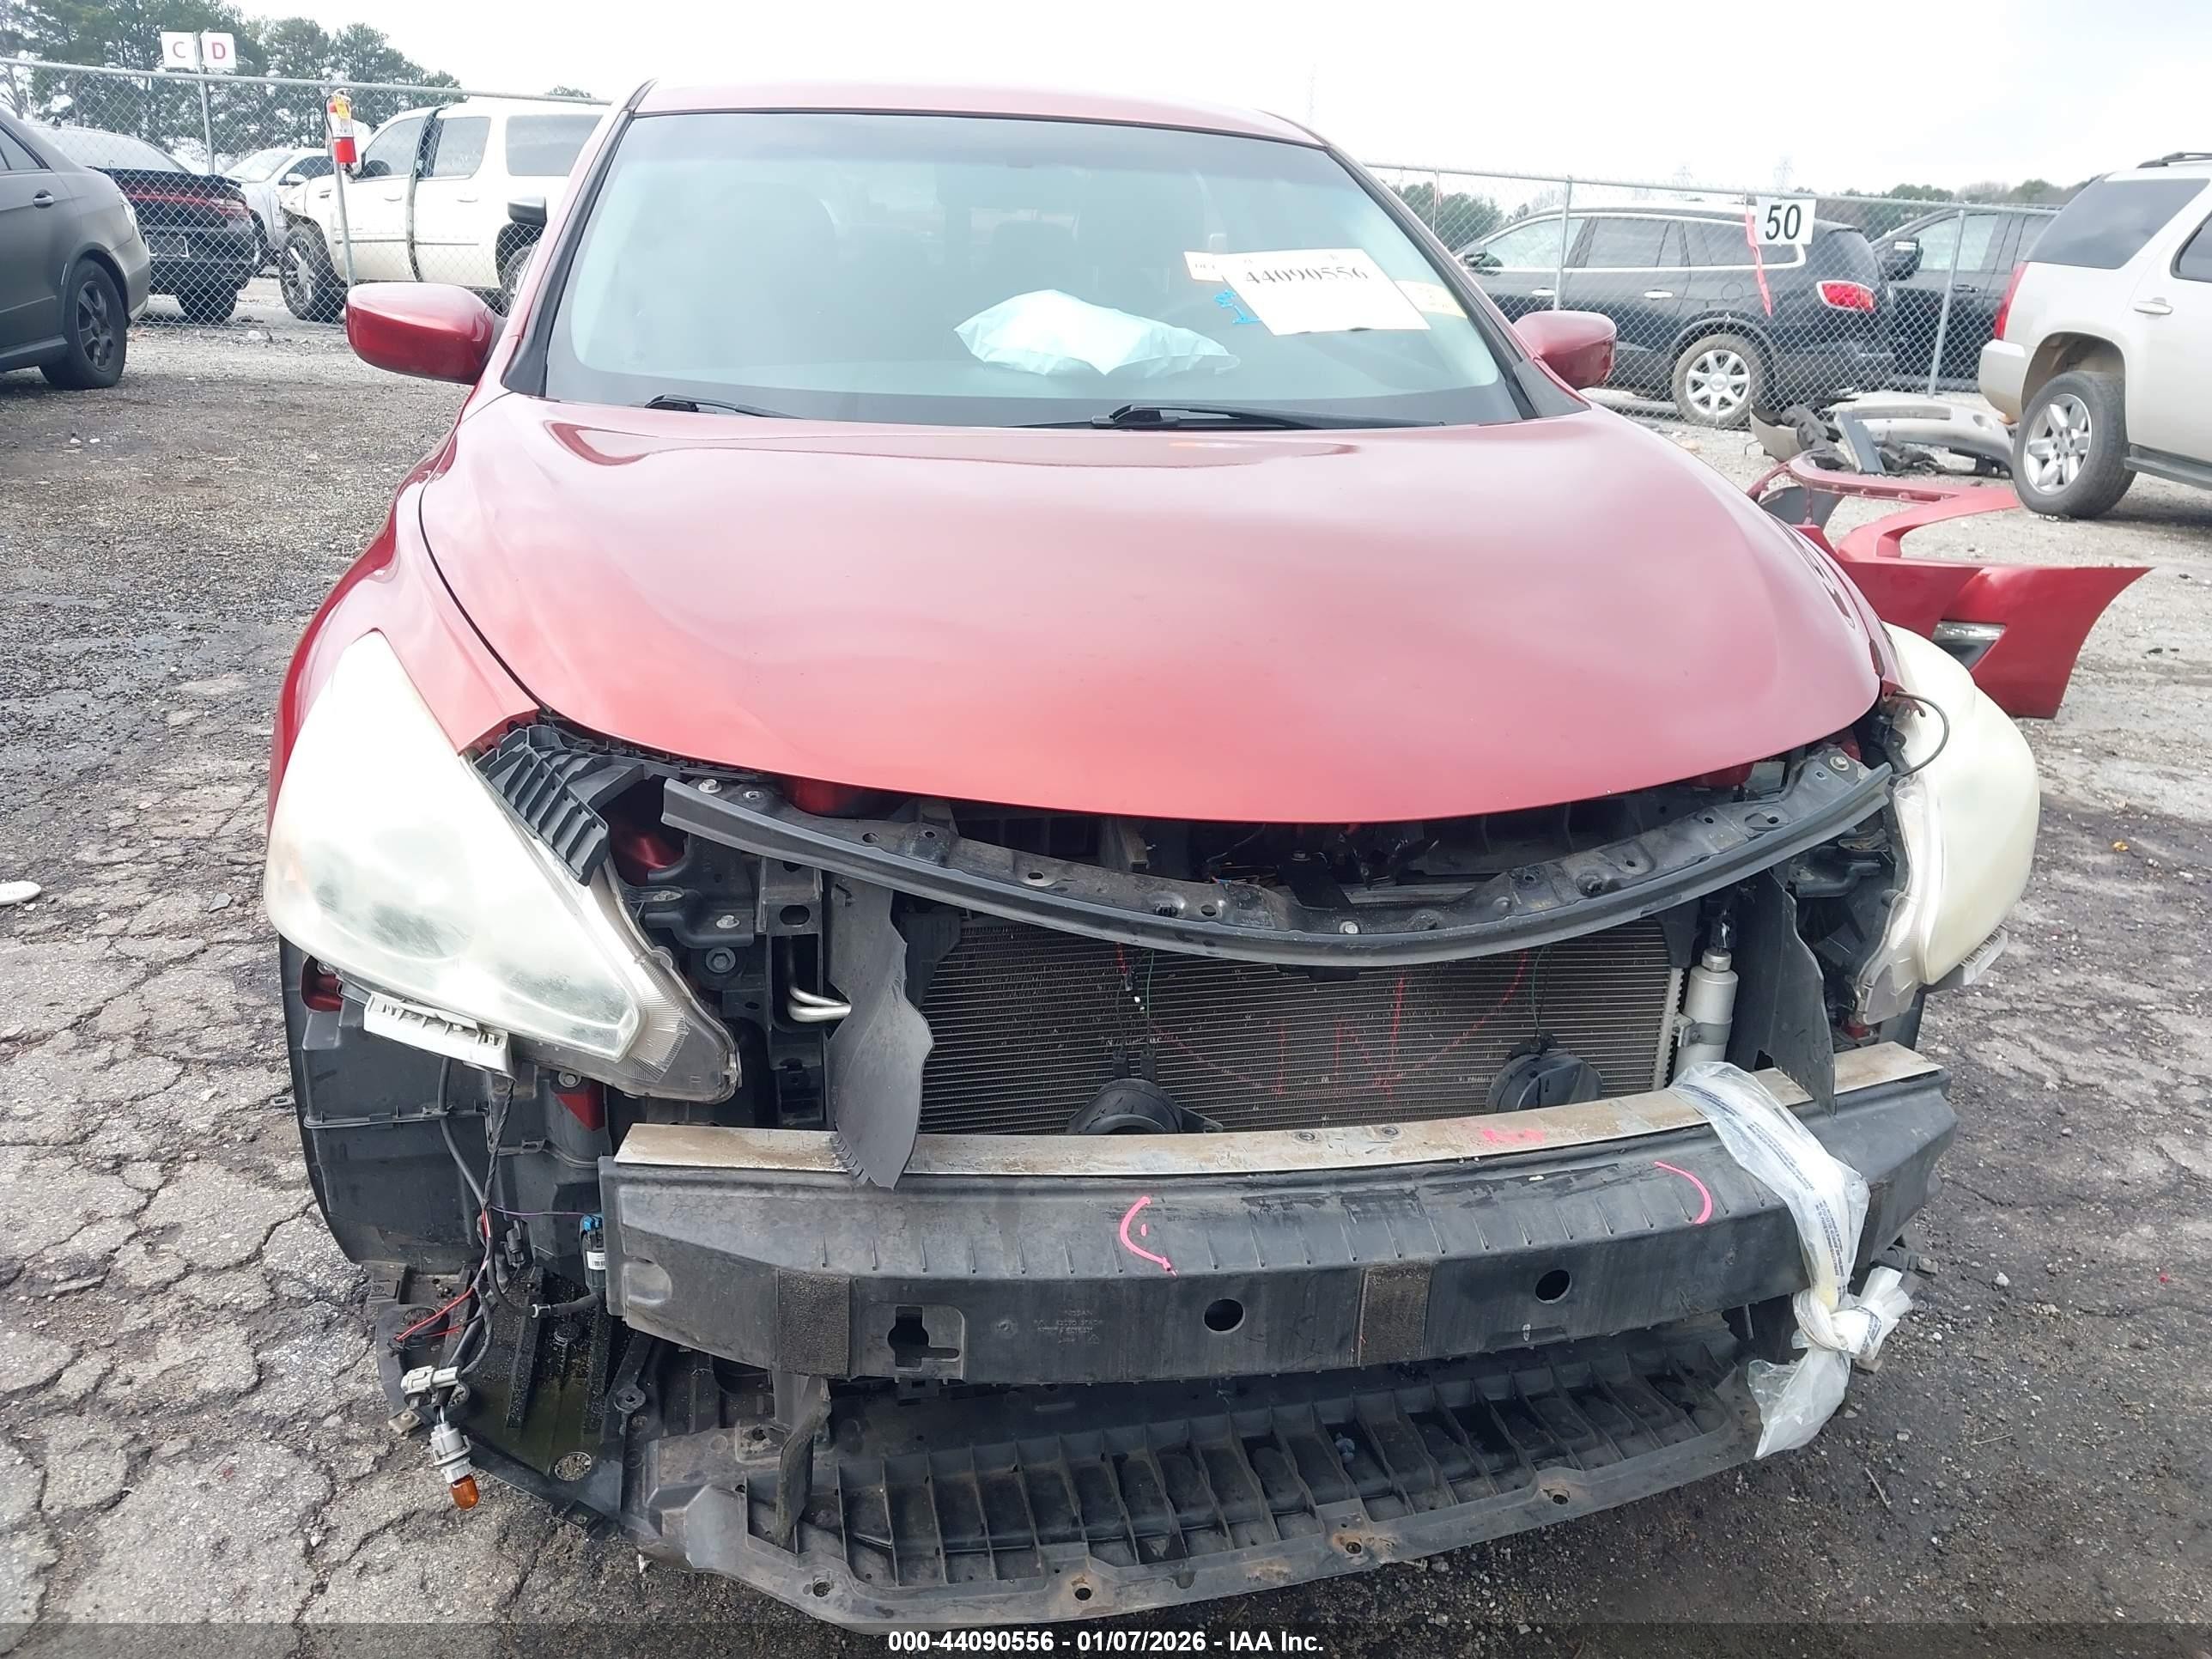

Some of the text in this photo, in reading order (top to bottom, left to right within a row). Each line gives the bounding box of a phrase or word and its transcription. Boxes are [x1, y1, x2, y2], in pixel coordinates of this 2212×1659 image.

[172, 40, 186, 59] C
[211, 41, 226, 59] D
[1765, 204, 1802, 240] 50
[1245, 266, 1369, 284] 44090556
